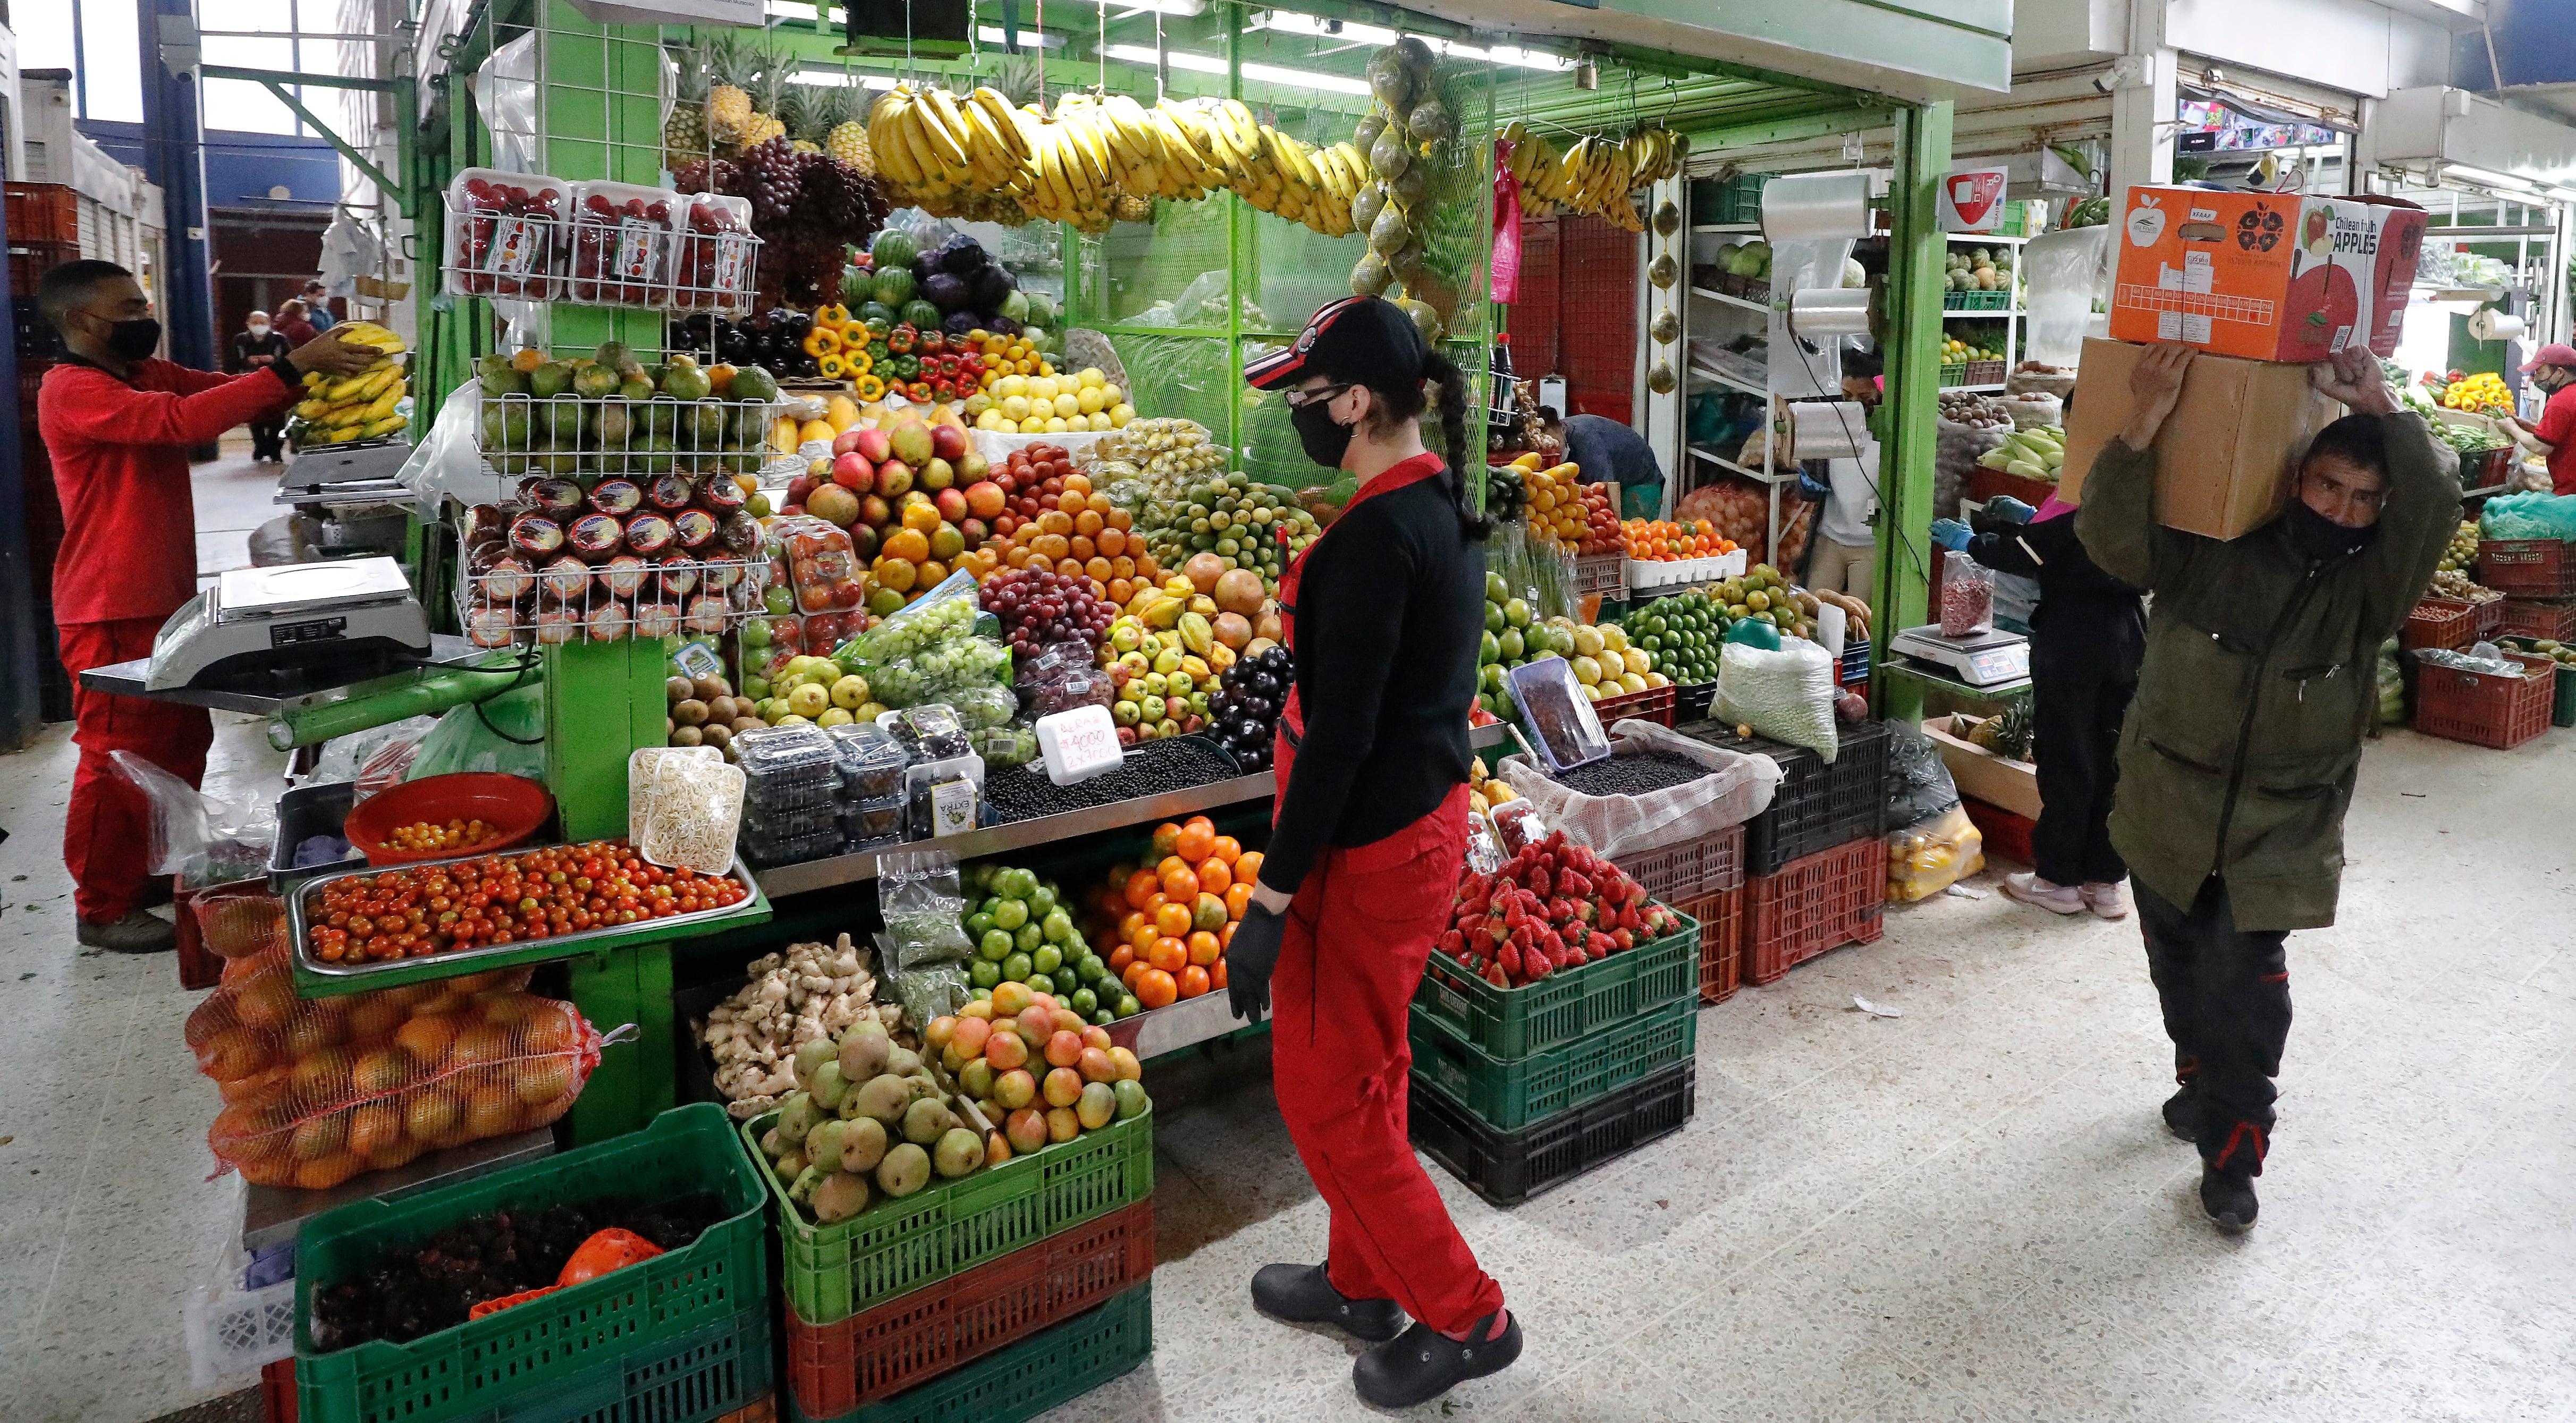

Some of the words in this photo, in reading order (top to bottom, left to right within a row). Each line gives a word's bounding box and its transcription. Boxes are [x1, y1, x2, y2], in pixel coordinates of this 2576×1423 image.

[2335, 216, 2360, 231] Chilean
[2332, 231, 2377, 255] APPLES
[940, 801, 969, 812] EXTRA
